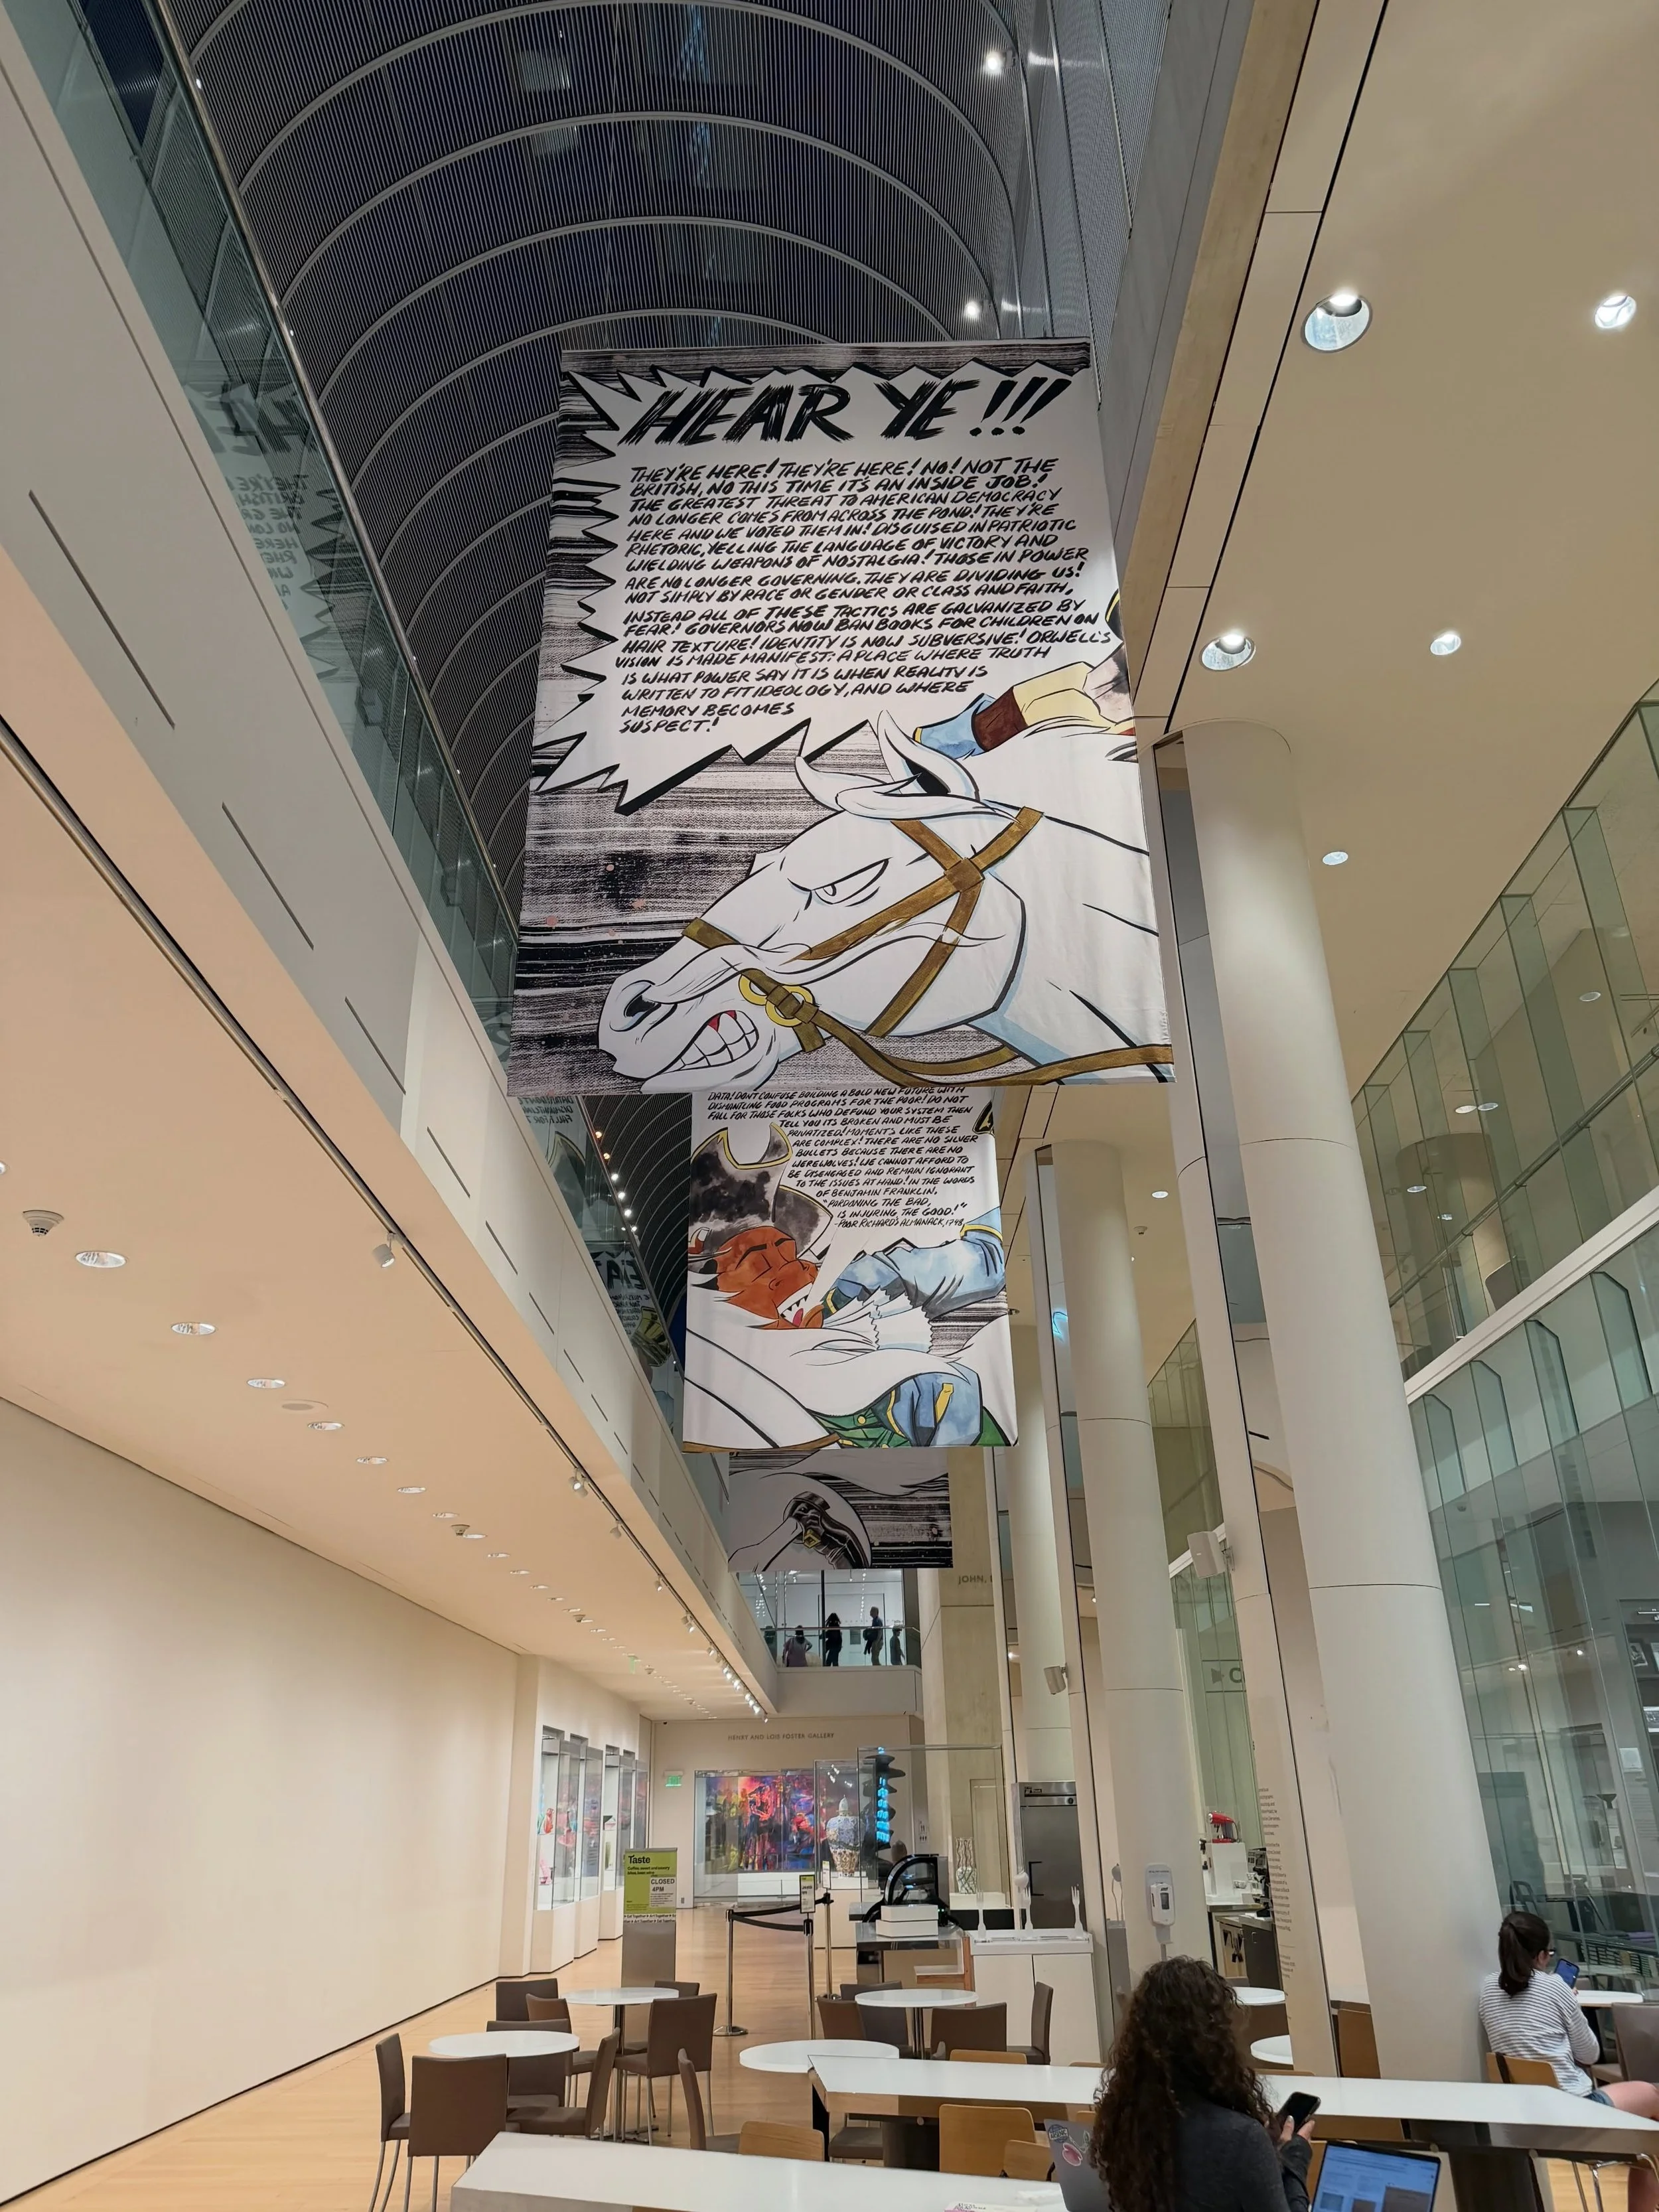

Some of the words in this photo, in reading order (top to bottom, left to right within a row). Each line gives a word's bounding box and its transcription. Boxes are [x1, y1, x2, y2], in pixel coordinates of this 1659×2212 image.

[618, 380, 854, 445] HEAR
[630, 463, 707, 482] THEY'RE
[706, 457, 780, 480] HERE!
[777, 458, 855, 479] THEY'RE
[853, 457, 922, 477] HERE!
[920, 457, 962, 475] NO!
[960, 457, 1012, 475] NOT
[1013, 458, 1059, 474] THE
[630, 482, 703, 498] BRITISH,
[706, 480, 735, 494] NO
[738, 480, 779, 495] THIS
[785, 479, 835, 494] TIME
[837, 476, 870, 492] IT'S
[874, 478, 907, 491] AN
[906, 475, 979, 490] INSIDE
[985, 473, 1048, 489] JOB!
[629, 498, 665, 512] THE
[668, 496, 761, 510] GREATEST
[765, 494, 838, 509] THREAT
[839, 493, 858, 506] TO
[859, 491, 950, 507] AMERICAN
[950, 487, 1062, 504] DEMOCRACY
[624, 542, 705, 557] RHETORIC,
[707, 540, 778, 555] YELLING
[781, 540, 814, 554] THE
[812, 538, 909, 554] LANGUAGE
[911, 537, 938, 551] OF
[940, 534, 1013, 550] VICTORY
[1014, 534, 1058, 548] AND
[626, 557, 706, 572] WIELDING
[711, 555, 794, 569] WEAPONS
[796, 554, 822, 569] OF
[824, 548, 935, 568] NOSTALGIA!
[933, 552, 994, 565] THOSE
[993, 550, 1018, 563] IN
[1017, 547, 1088, 563] POWER
[622, 609, 696, 625] INSTEAD
[697, 608, 728, 623] ALL
[733, 607, 762, 621] OF
[764, 604, 829, 621] THESE
[832, 605, 899, 619] TACTICS
[901, 603, 940, 616] ARE
[941, 600, 1053, 615] GALVANIZED
[1055, 598, 1087, 613] BY
[622, 622, 682, 638] FEAR!
[684, 619, 786, 636] GOVERNORS
[787, 618, 834, 632] NOW
[833, 619, 870, 632] BAN
[874, 618, 933, 631] BOOKS
[937, 617, 975, 630] FOR
[979, 613, 1070, 628] CHILDREN
[1073, 612, 1100, 626] ON
[621, 640, 668, 654] HAIR
[670, 634, 762, 654] TEXTURE!
[758, 635, 836, 650] IDENTITY
[839, 635, 858, 648] IS
[860, 634, 904, 648] NOW
[907, 628, 1028, 648] SUBVERSIVE!
[1026, 629, 1112, 644] ORWELL'S
[620, 687, 697, 701] WRITTEN
[699, 688, 721, 700] TO
[721, 686, 755, 700] FIT
[752, 682, 850, 698] IDEOLOGY,
[851, 682, 894, 697] AND
[895, 680, 975, 696] WHERE
[620, 705, 701, 718] MEMORY
[702, 702, 796, 717] BECOMES
[618, 716, 720, 734] SUSPECT!
[707, 1101, 762, 1111] DISMANTLING
[790, 1098, 847, 1108] PROGRAMS
[896, 1094, 928, 1104] POOR!
[926, 1095, 942, 1104] DO
[943, 1095, 969, 1104] NOT
[802, 1118, 822, 1127] YOU
[840, 1117, 881, 1126] BROKEN
[932, 1115, 953, 1124] BE
[787, 1126, 847, 1137] PRIVATIZED!
[845, 1127, 896, 1136] MOMENTS
[899, 1126, 922, 1135] LIKE
[925, 1125, 961, 1134] THESE
[814, 1136, 864, 1146] COMPLEX!
[865, 1137, 900, 1145] THERE
[901, 1136, 925, 1145] ARE
[944, 1135, 979, 1143] SILVER
[796, 1148, 838, 1157] BULLETS
[889, 1146, 924, 1155] THERE
[925, 1145, 947, 1154] ARE
[792, 1156, 860, 1167] WEREWOLVES!
[859, 1157, 877, 1166] WE
[877, 1157, 916, 1165] CANNOT
[956, 1155, 969, 1164] TO
[787, 1169, 802, 1178] BE
[804, 1169, 862, 1178] DISENGAGED
[886, 1166, 924, 1175] REMAIN
[925, 1165, 975, 1174] IGNORANT
[831, 1189, 882, 1197] BENJAMIN
[883, 1187, 938, 1195] FRANKLIN.
[823, 1199, 879, 1208] "PARDONING
[881, 1198, 902, 1207] THE
[905, 1197, 932, 1207] BAD,
[837, 1210, 847, 1218] IS
[628, 1854, 650, 1864] Taste
